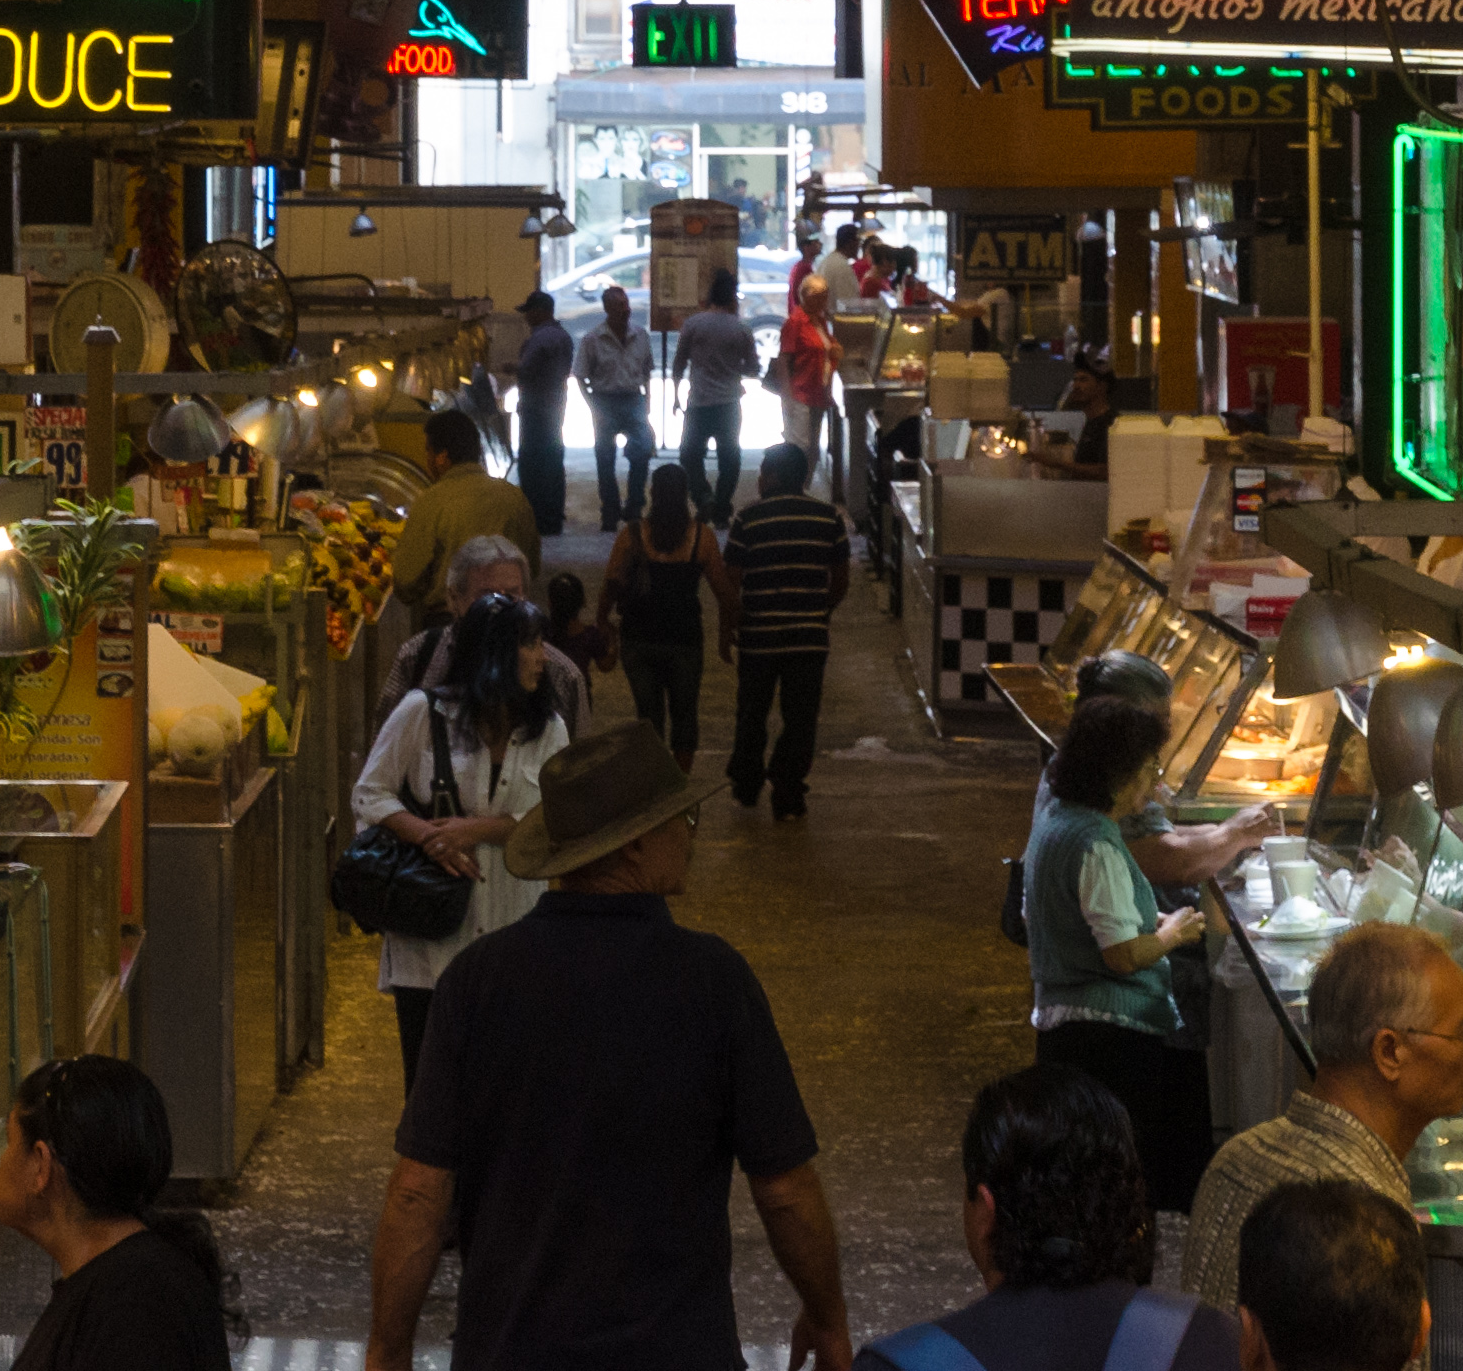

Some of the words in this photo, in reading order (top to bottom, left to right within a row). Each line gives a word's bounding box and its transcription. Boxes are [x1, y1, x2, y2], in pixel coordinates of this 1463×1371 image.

[387, 43, 455, 75] FOOD
[779, 90, 828, 114] 318
[1130, 83, 1295, 119] FOODS
[967, 230, 1064, 269] ATM
